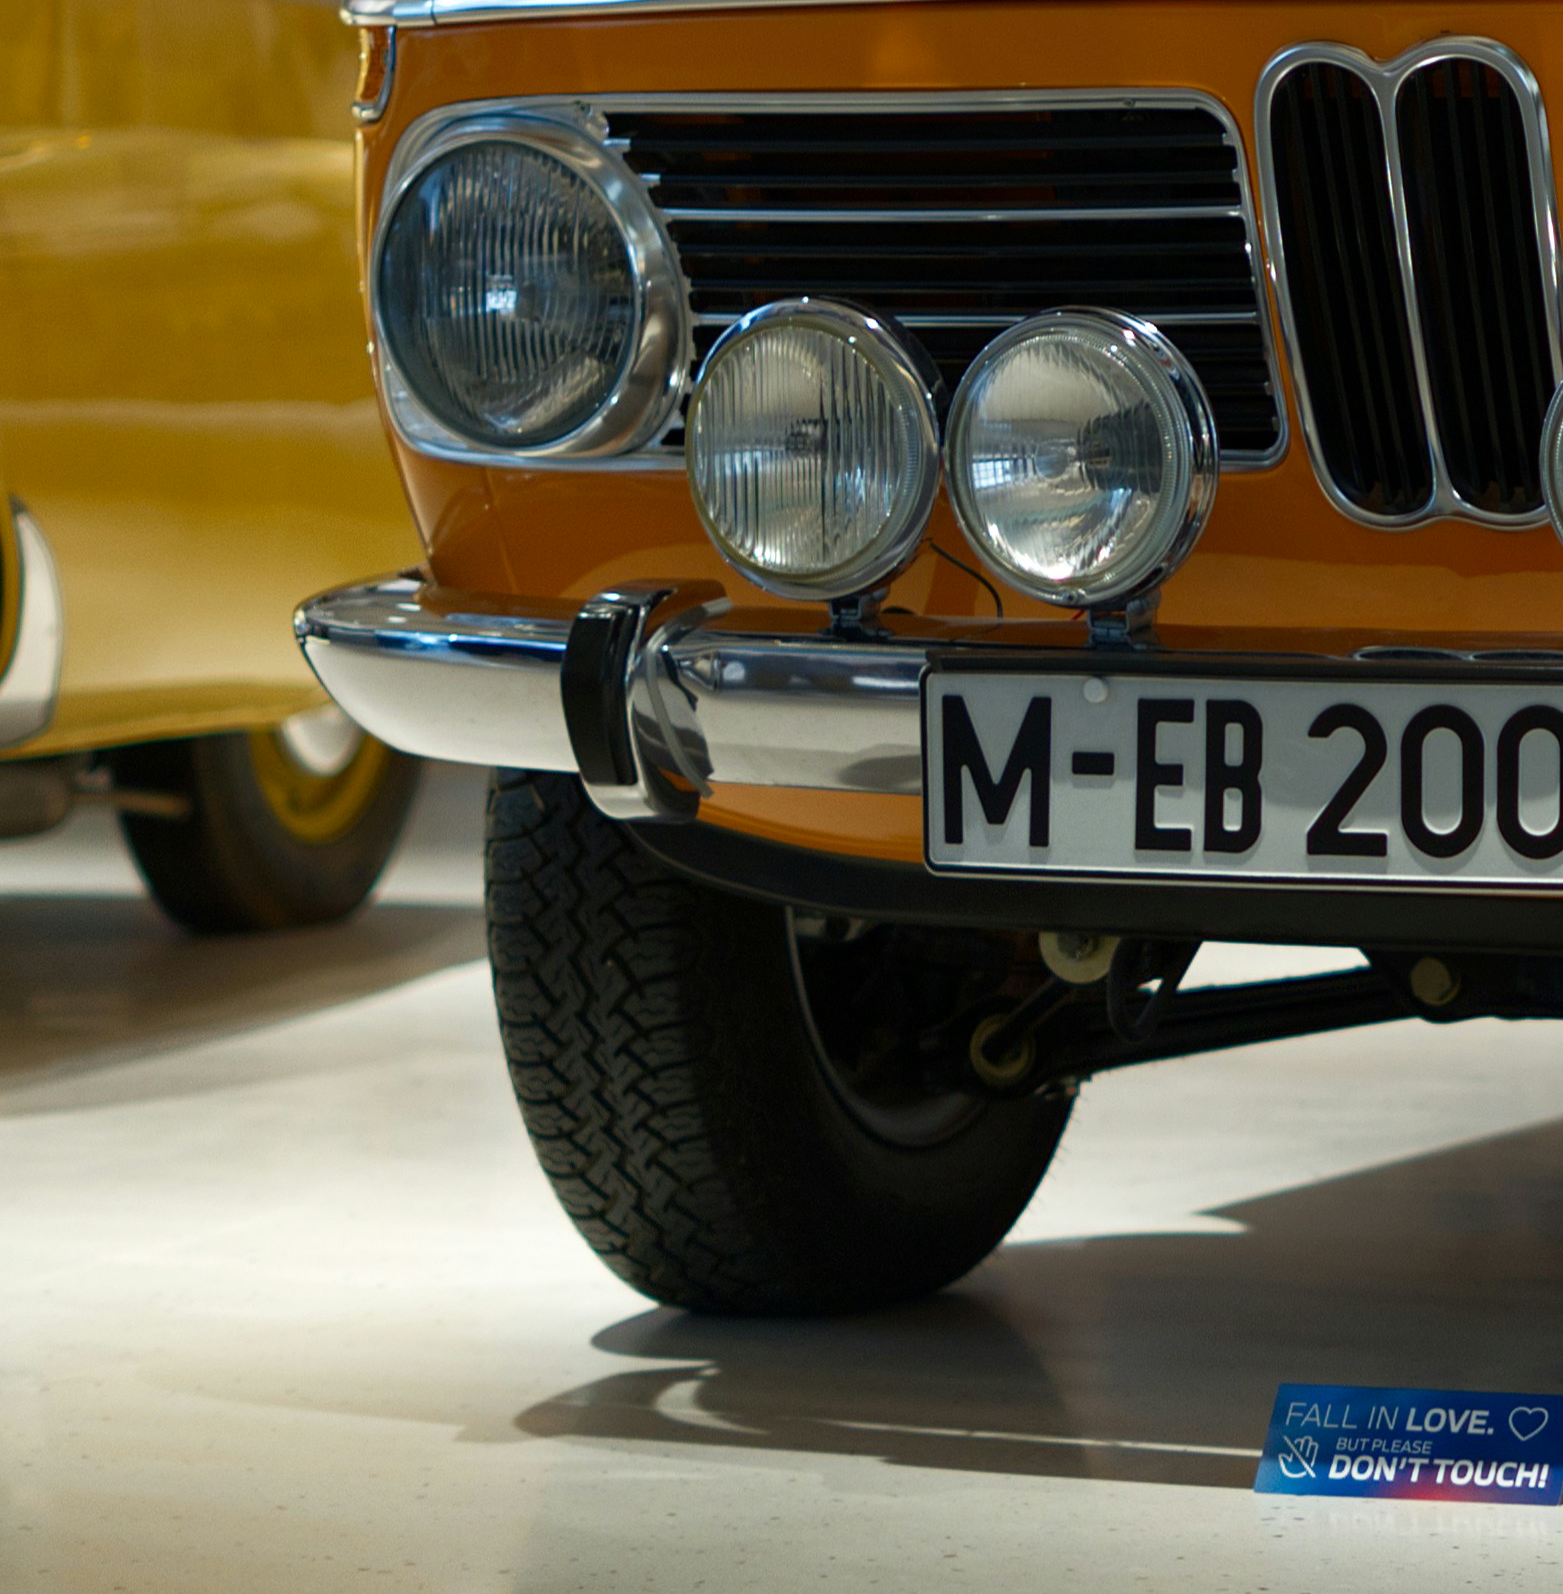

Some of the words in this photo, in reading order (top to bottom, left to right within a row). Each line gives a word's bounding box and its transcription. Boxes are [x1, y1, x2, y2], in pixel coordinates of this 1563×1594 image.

[941, 694, 1264, 854] M-EB
[1286, 1402, 1358, 1429] FALL
[1367, 1405, 1399, 1430] IN
[1405, 1407, 1494, 1435] LOVE.
[1336, 1437, 1370, 1452] BUT
[1371, 1438, 1433, 1455] PLEASE
[1328, 1454, 1430, 1483] DON'T
[1433, 1459, 1550, 1489] TOUCH!
